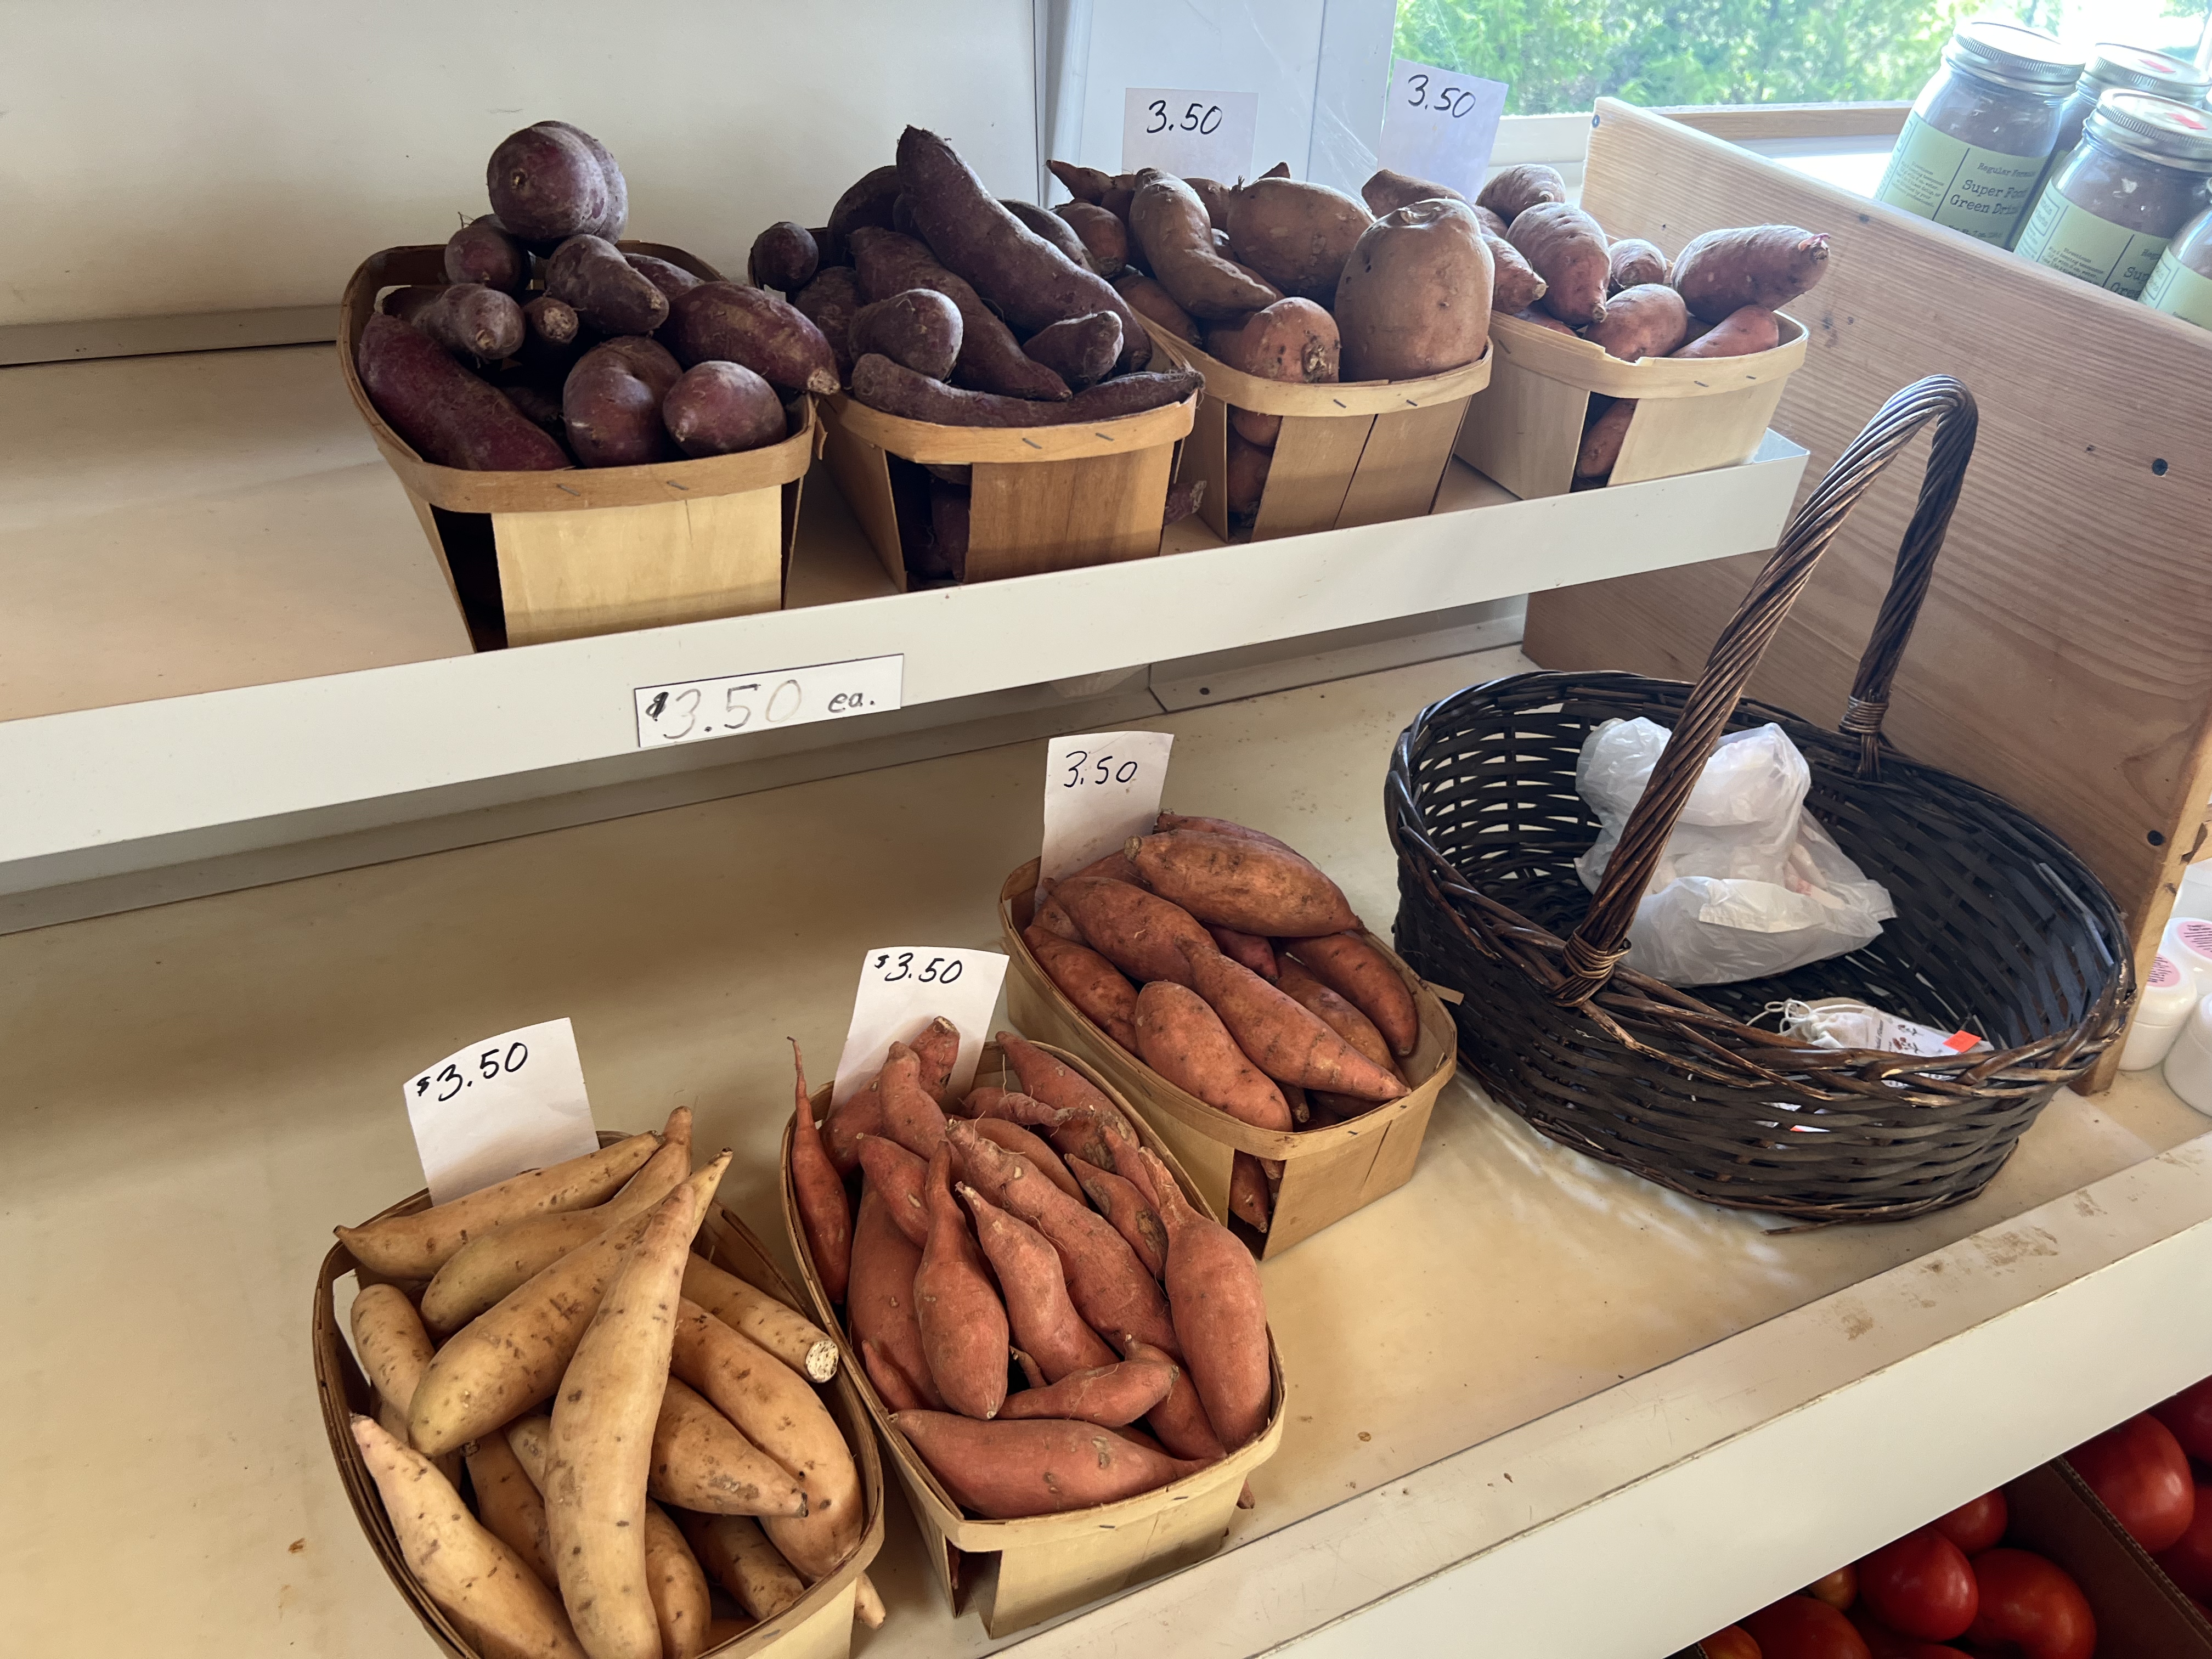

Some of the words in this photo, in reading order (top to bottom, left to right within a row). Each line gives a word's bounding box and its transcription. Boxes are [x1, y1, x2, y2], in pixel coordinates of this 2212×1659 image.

[1407, 74, 1476, 118] 3.50
[1146, 100, 1223, 135] 3.50
[1977, 162, 2011, 176] Regular
[1950, 194, 1990, 213] Green
[1962, 179, 2004, 197] Super
[645, 679, 802, 739] $3.50
[828, 691, 876, 713] ea.
[1063, 751, 1138, 788] 3.50
[874, 952, 963, 984] $3.50
[416, 1042, 528, 1102] $3.50
